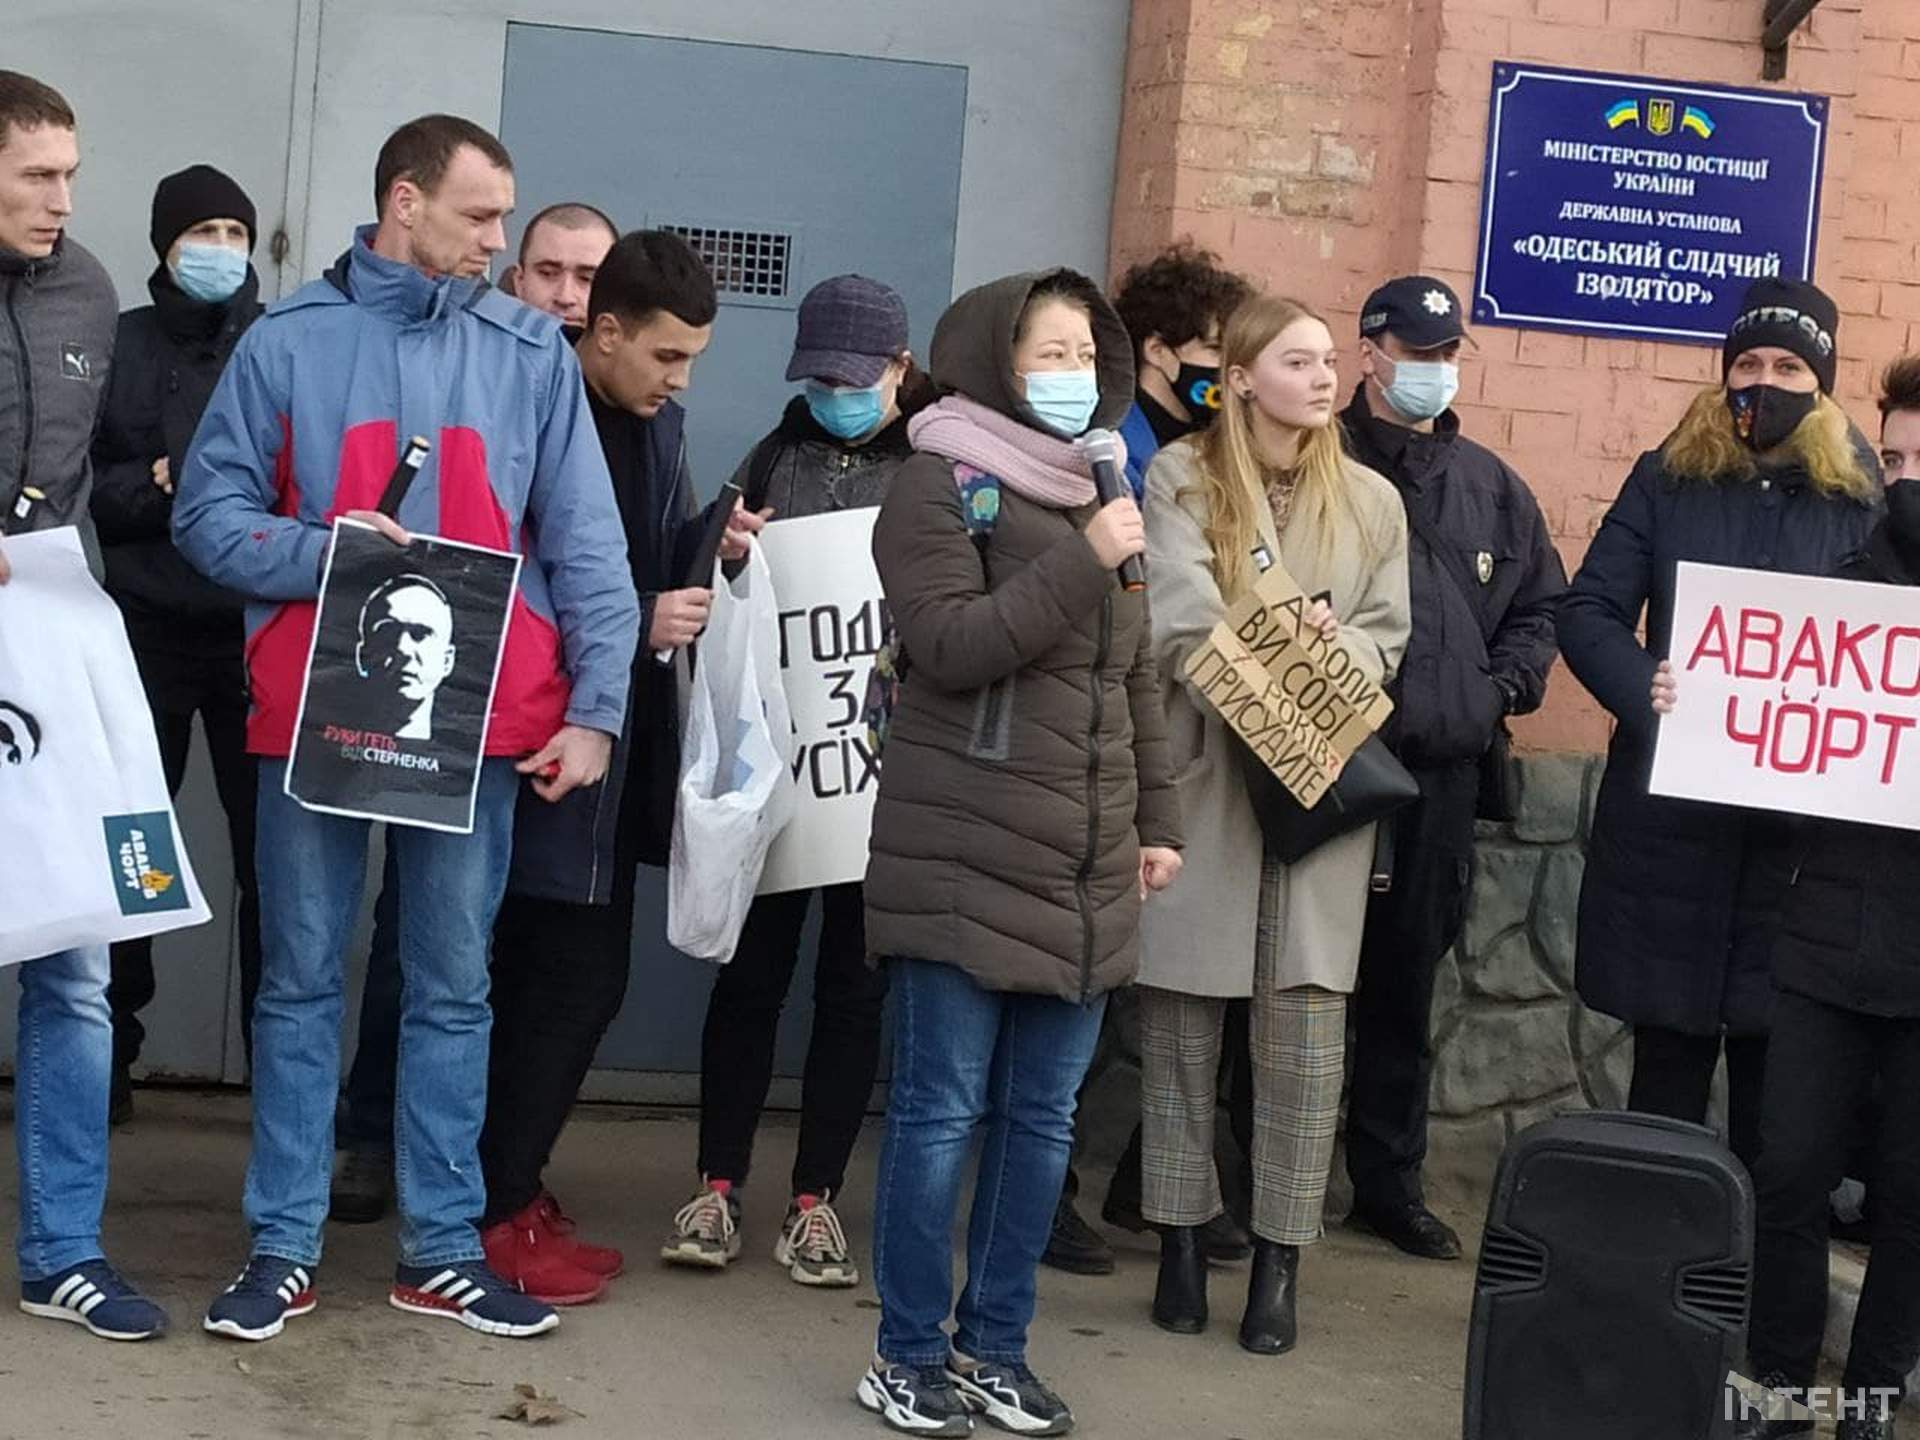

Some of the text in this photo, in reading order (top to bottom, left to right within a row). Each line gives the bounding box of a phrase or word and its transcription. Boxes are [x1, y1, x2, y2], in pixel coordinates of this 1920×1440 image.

[1544, 140, 1770, 180] МІНІСТЕРСТВО ЮСТИЦІЇ
[1613, 171, 1695, 196] УКРАЇНИ
[1559, 201, 1742, 235] ДЕРЖАВНА УСТАНОВА
[1513, 234, 1781, 278] «ОДЕСЬКИЙ СЛІДЧИЙ
[1576, 272, 1714, 305] ІЗОЛЯТОР»
[1271, 596, 1304, 638] А
[1686, 604, 1920, 697] АВАКО
[1236, 607, 1357, 741] ВИ СОБІ
[1189, 650, 1325, 802] ПРИСУДИТЕ
[1725, 694, 1917, 785] ЧОРТ
[363, 747, 439, 772] СТЕРНЕНКА
[119, 842, 140, 889] ЧОРТ
